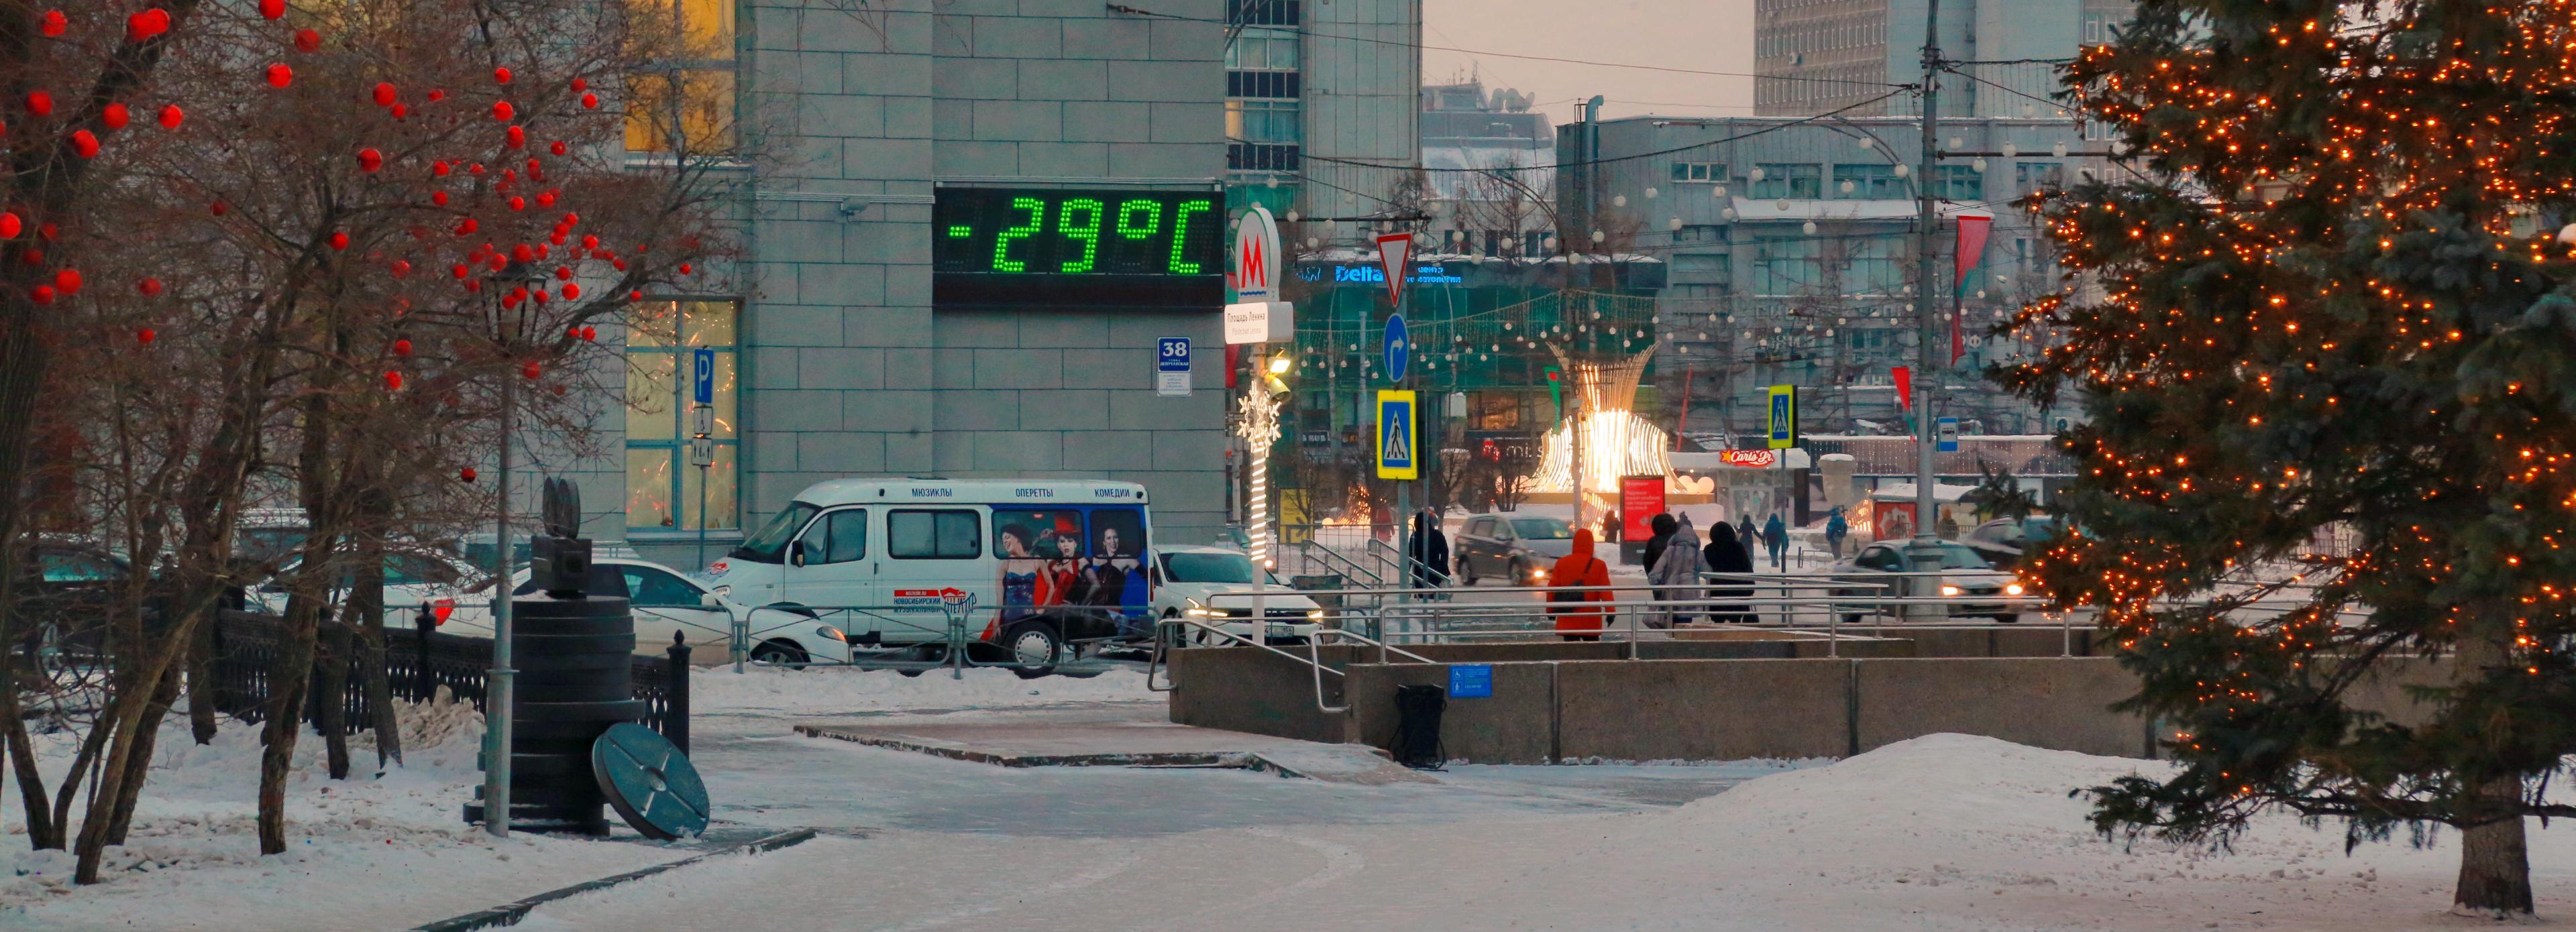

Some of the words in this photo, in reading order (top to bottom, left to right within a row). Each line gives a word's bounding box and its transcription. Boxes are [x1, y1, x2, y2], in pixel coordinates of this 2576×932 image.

[1241, 232, 1265, 288] М
[1336, 266, 1385, 282] Delta
[1227, 312, 1248, 323] Площадь
[1248, 311, 1265, 322] Ленина
[1163, 342, 1187, 357] 38
[699, 354, 710, 397] P
[1730, 451, 1758, 463] Carl's
[1758, 451, 1774, 463] Jr.
[912, 488, 952, 498] МЮЗИКЛЫ
[1015, 488, 1053, 498] ОПЕРЕТТЫ
[1094, 488, 1130, 498] КОМЕДИИ
